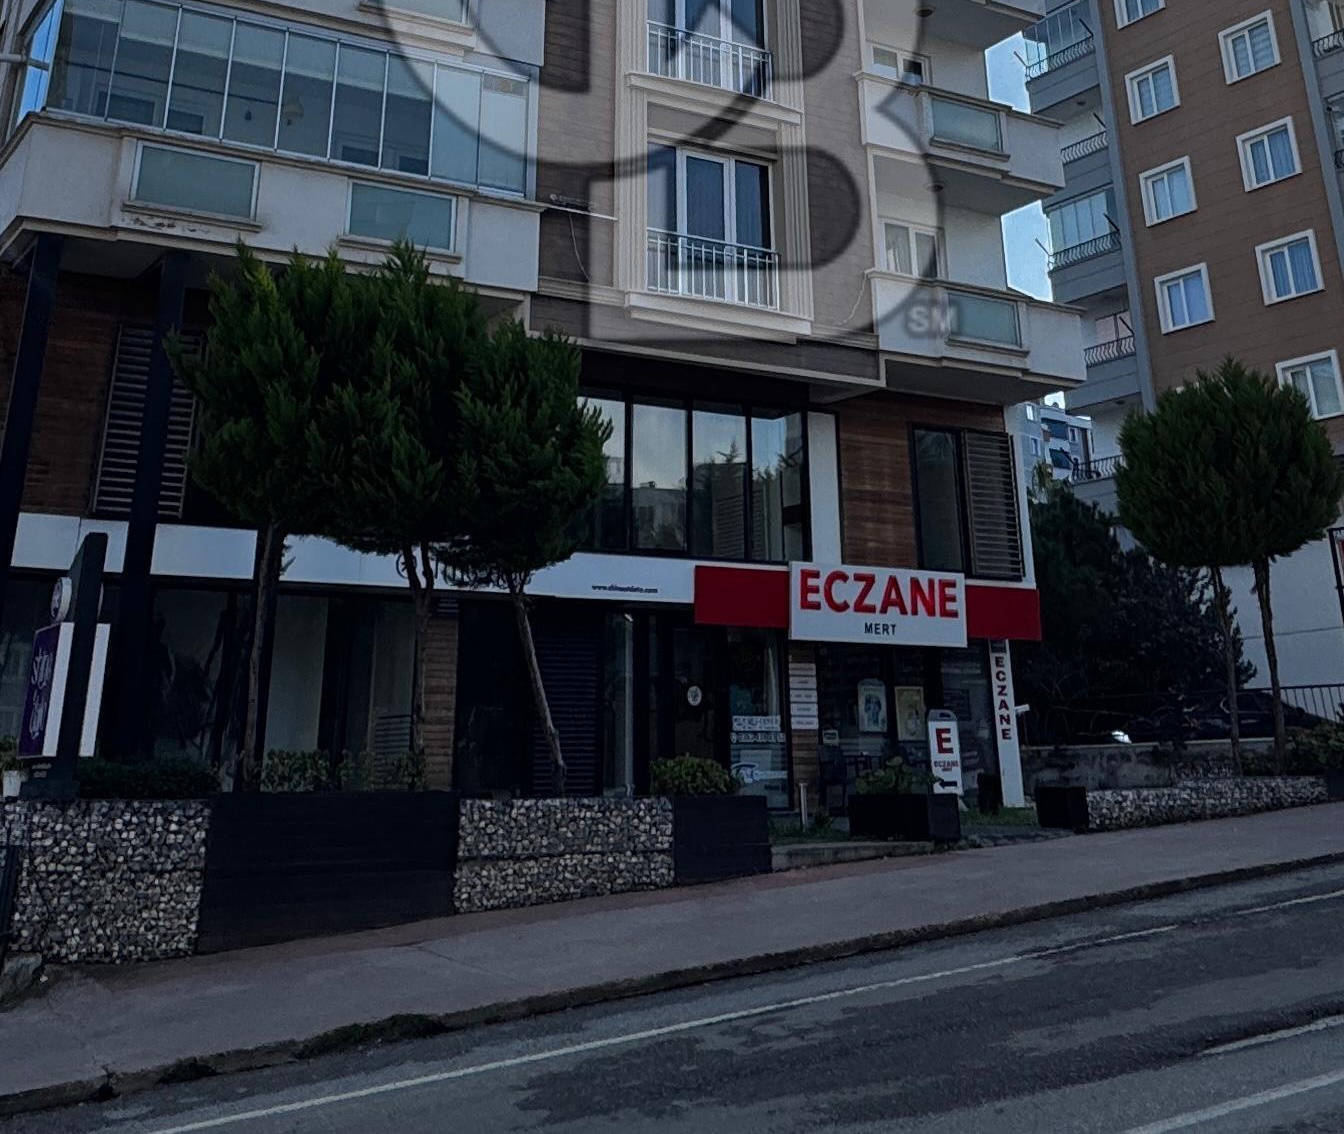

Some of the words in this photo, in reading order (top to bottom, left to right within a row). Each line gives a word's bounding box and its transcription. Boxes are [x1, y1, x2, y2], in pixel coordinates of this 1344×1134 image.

[800, 569, 959, 618] ECZANE
[864, 622, 896, 636] MERT
[995, 656, 1012, 740] ECZANE
[935, 728, 954, 754] E
